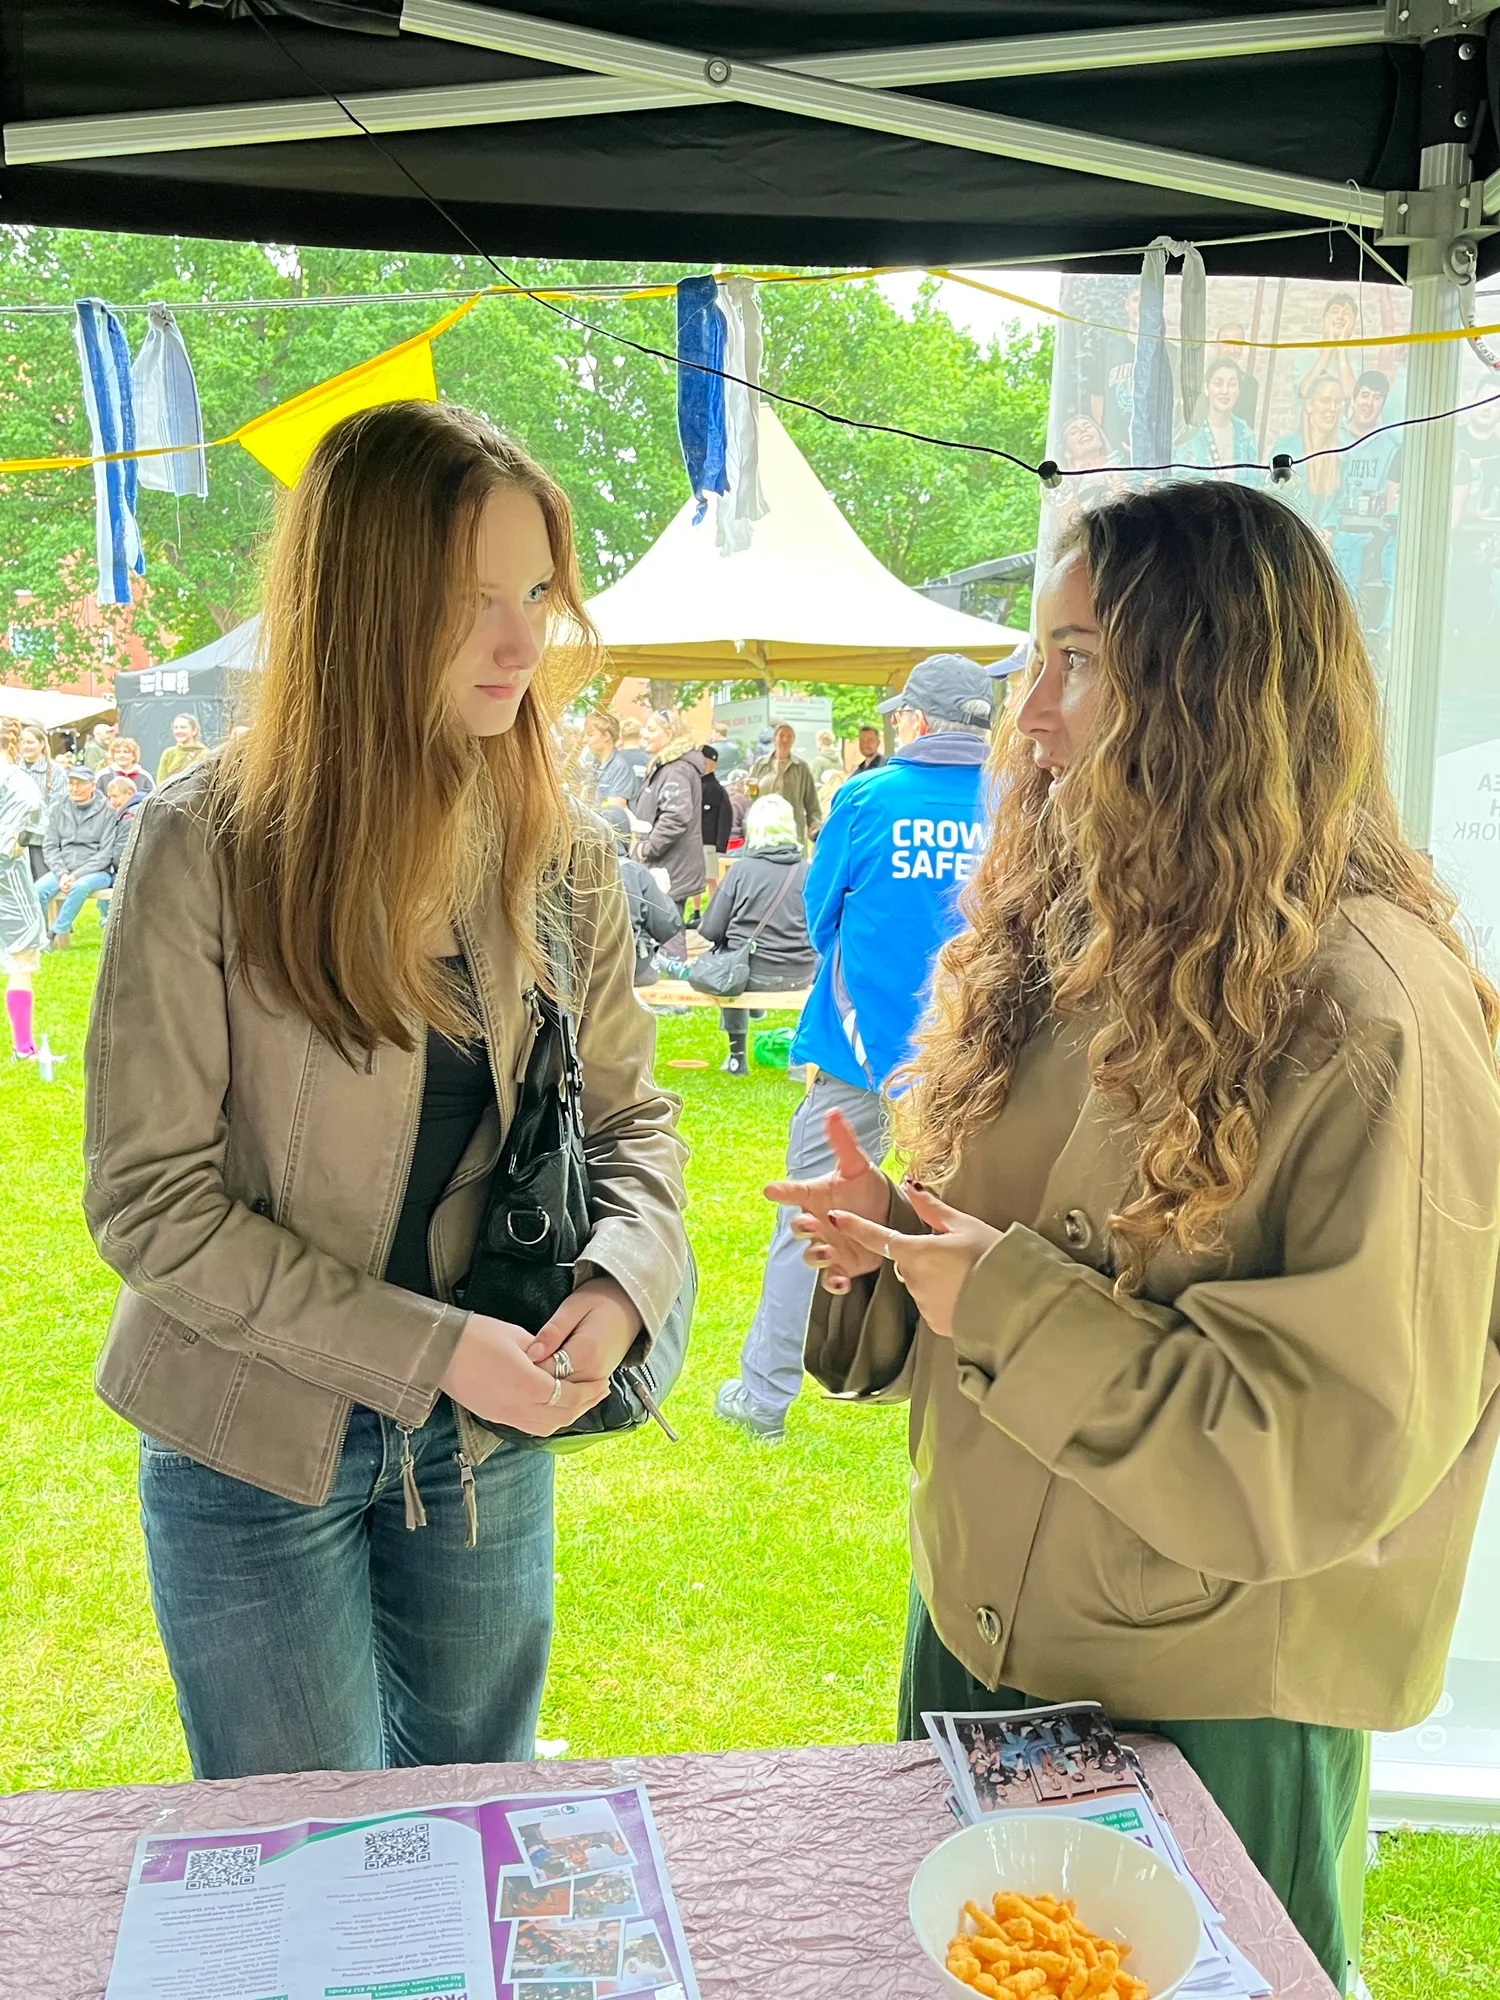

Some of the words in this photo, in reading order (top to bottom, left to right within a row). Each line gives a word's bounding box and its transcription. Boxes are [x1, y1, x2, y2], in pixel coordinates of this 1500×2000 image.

[892, 818, 986, 850] CROW
[891, 849, 977, 881] SAFE
[1121, 1818, 1139, 1828] Join
[378, 1981, 410, 1991] covered
[412, 1976, 449, 1986] expenses
[409, 1985, 434, 1994] Learn,
[435, 1982, 462, 1991] Travel,
[374, 1989, 408, 1998] Connect
